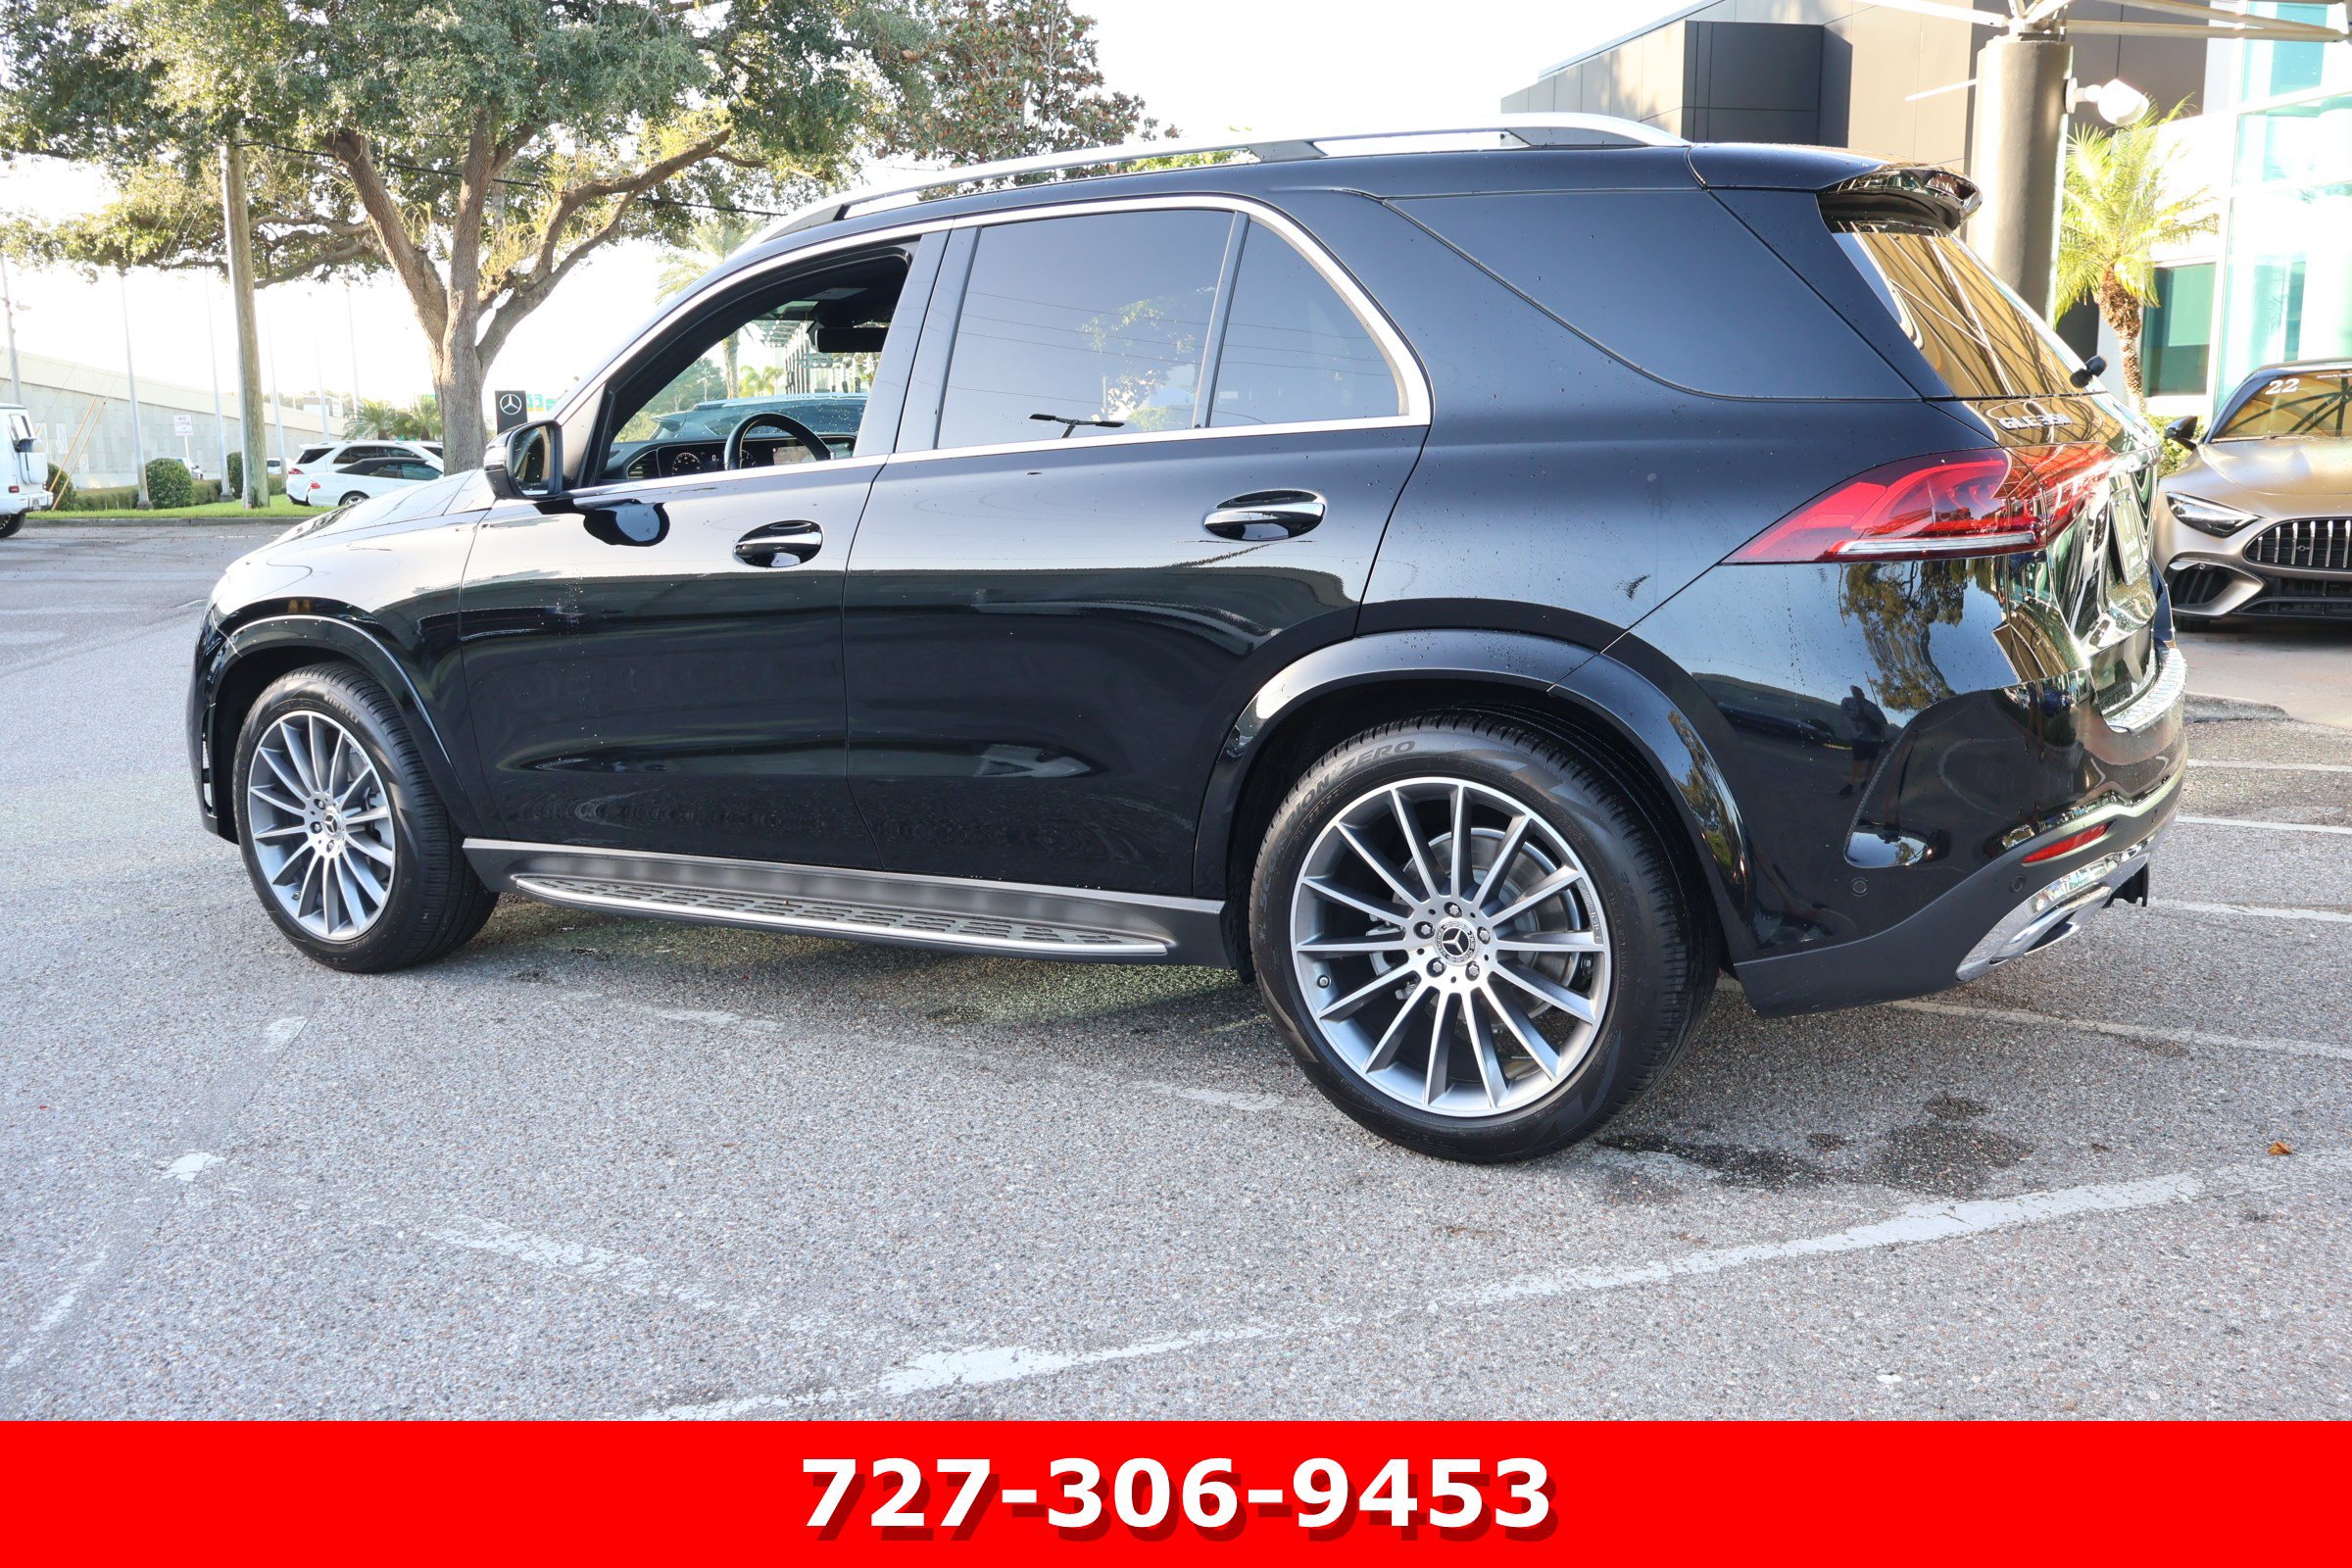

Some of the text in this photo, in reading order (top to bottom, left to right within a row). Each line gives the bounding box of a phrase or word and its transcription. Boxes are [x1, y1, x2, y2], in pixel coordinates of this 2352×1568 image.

[2265, 378, 2300, 395] 22
[323, 694, 359, 724] PIRELLI
[1339, 740, 1415, 777] ZERO
